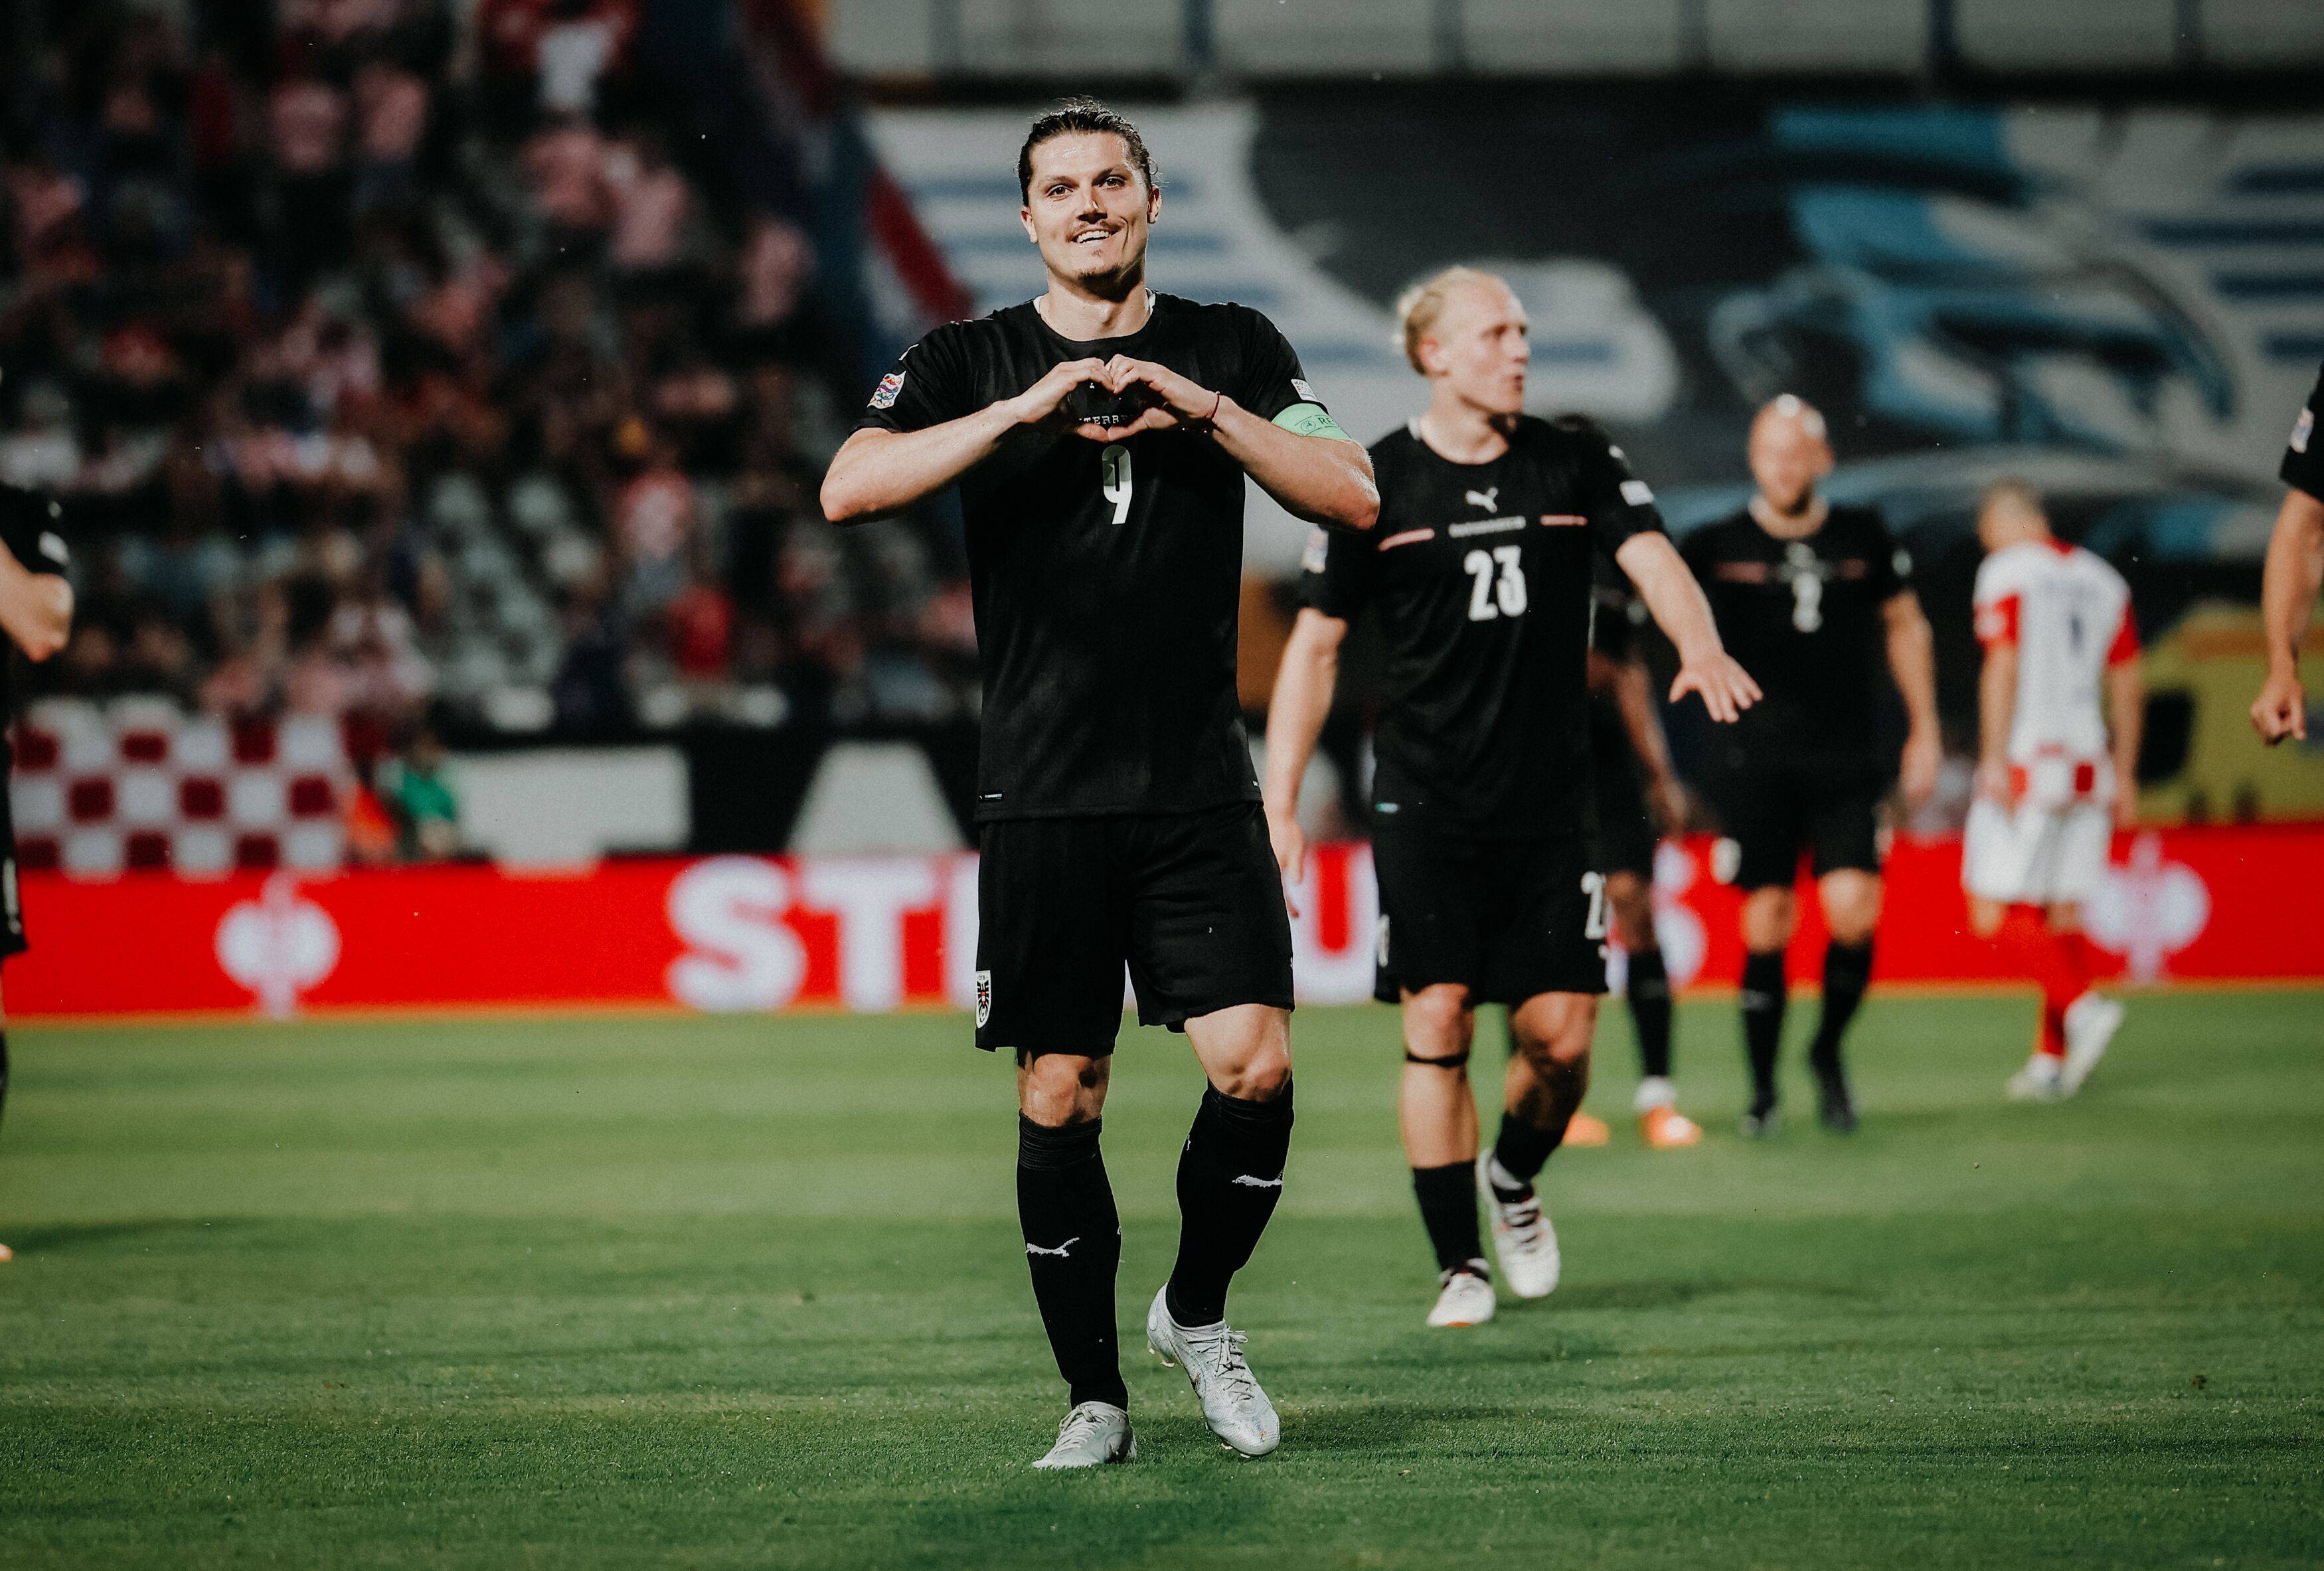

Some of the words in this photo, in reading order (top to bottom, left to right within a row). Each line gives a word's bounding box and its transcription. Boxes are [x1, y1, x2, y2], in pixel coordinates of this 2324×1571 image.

[1078, 414, 1127, 425] TERR
[1318, 417, 1337, 426] RE
[1102, 444, 1133, 525] 9
[1463, 544, 1527, 621] 23
[1580, 870, 1608, 940] 2
